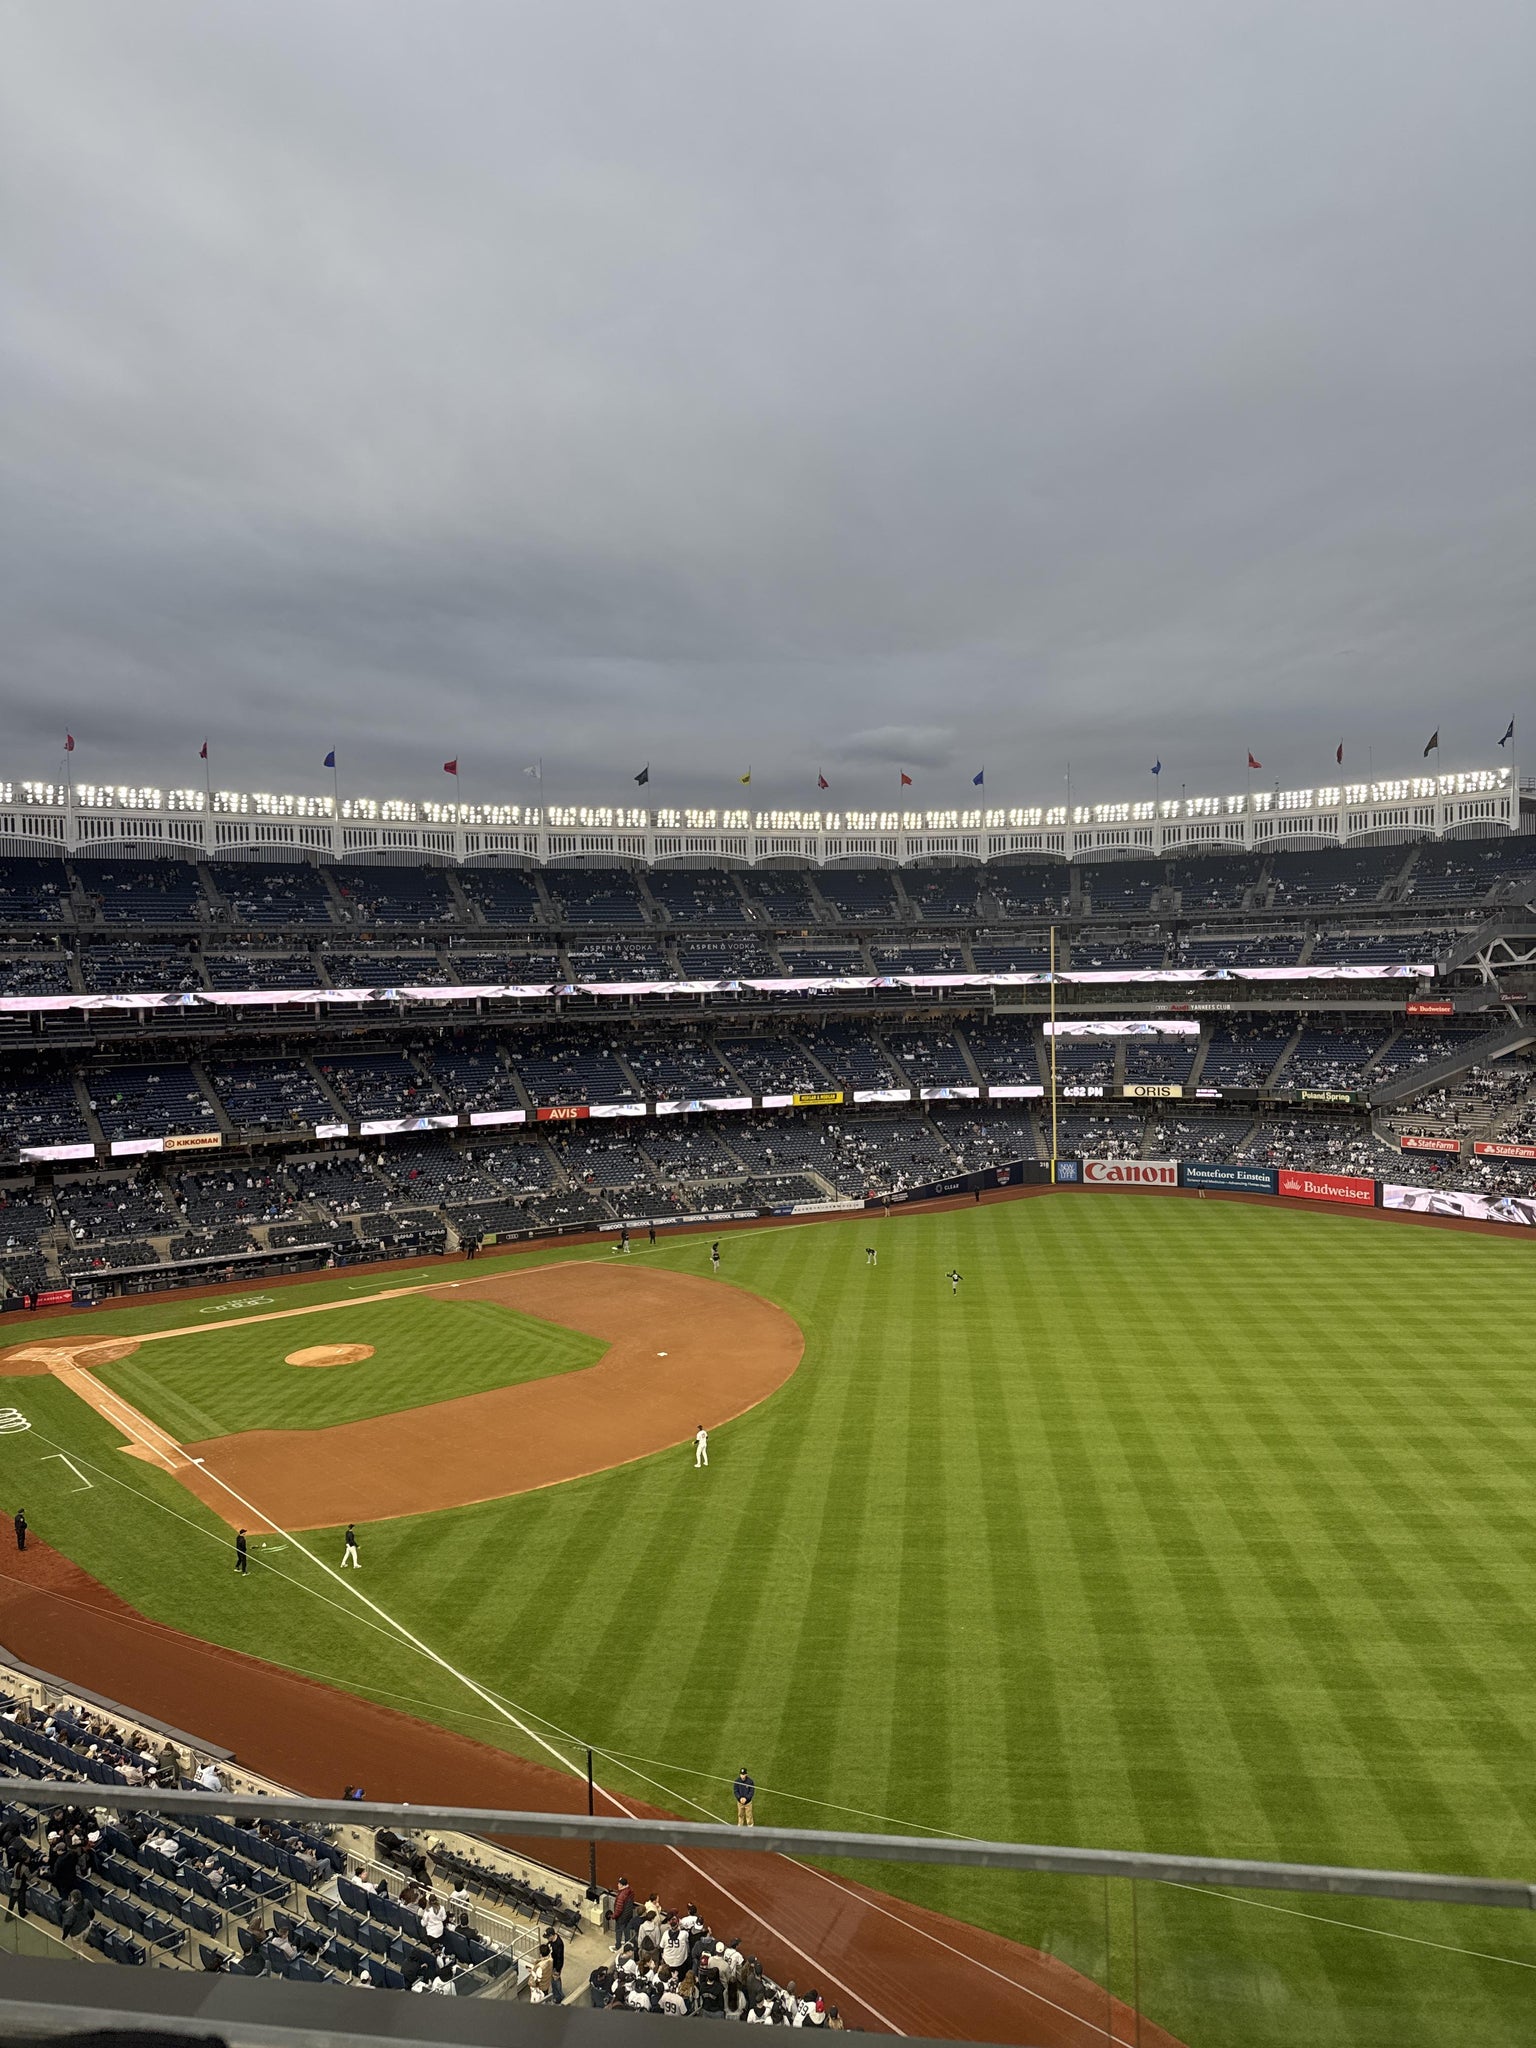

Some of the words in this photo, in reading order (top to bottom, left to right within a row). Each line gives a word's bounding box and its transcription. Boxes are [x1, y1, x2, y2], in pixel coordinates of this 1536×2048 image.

[1063, 1086, 1086, 1097] 6:52
[1087, 1087, 1103, 1097] PM
[1134, 1086, 1171, 1097] ORIS
[1301, 1091, 1326, 1100] Poland
[1326, 1092, 1350, 1102] Spring
[549, 1108, 578, 1119] AVIS
[177, 1137, 219, 1147] KIKKOMAN
[1418, 1140, 1435, 1149] State
[1435, 1141, 1454, 1150] Farm
[1496, 1146, 1515, 1155] State
[1515, 1147, 1535, 1157] Farm
[1085, 1162, 1175, 1184] Canon
[1186, 1168, 1235, 1179] Montefiore
[1237, 1171, 1271, 1182] Einstein
[944, 1183, 960, 1191] CLEAR
[1303, 1180, 1371, 1200] Budweiser
[668, 1939, 680, 1948] 99
[665, 2001, 677, 2013] 99
